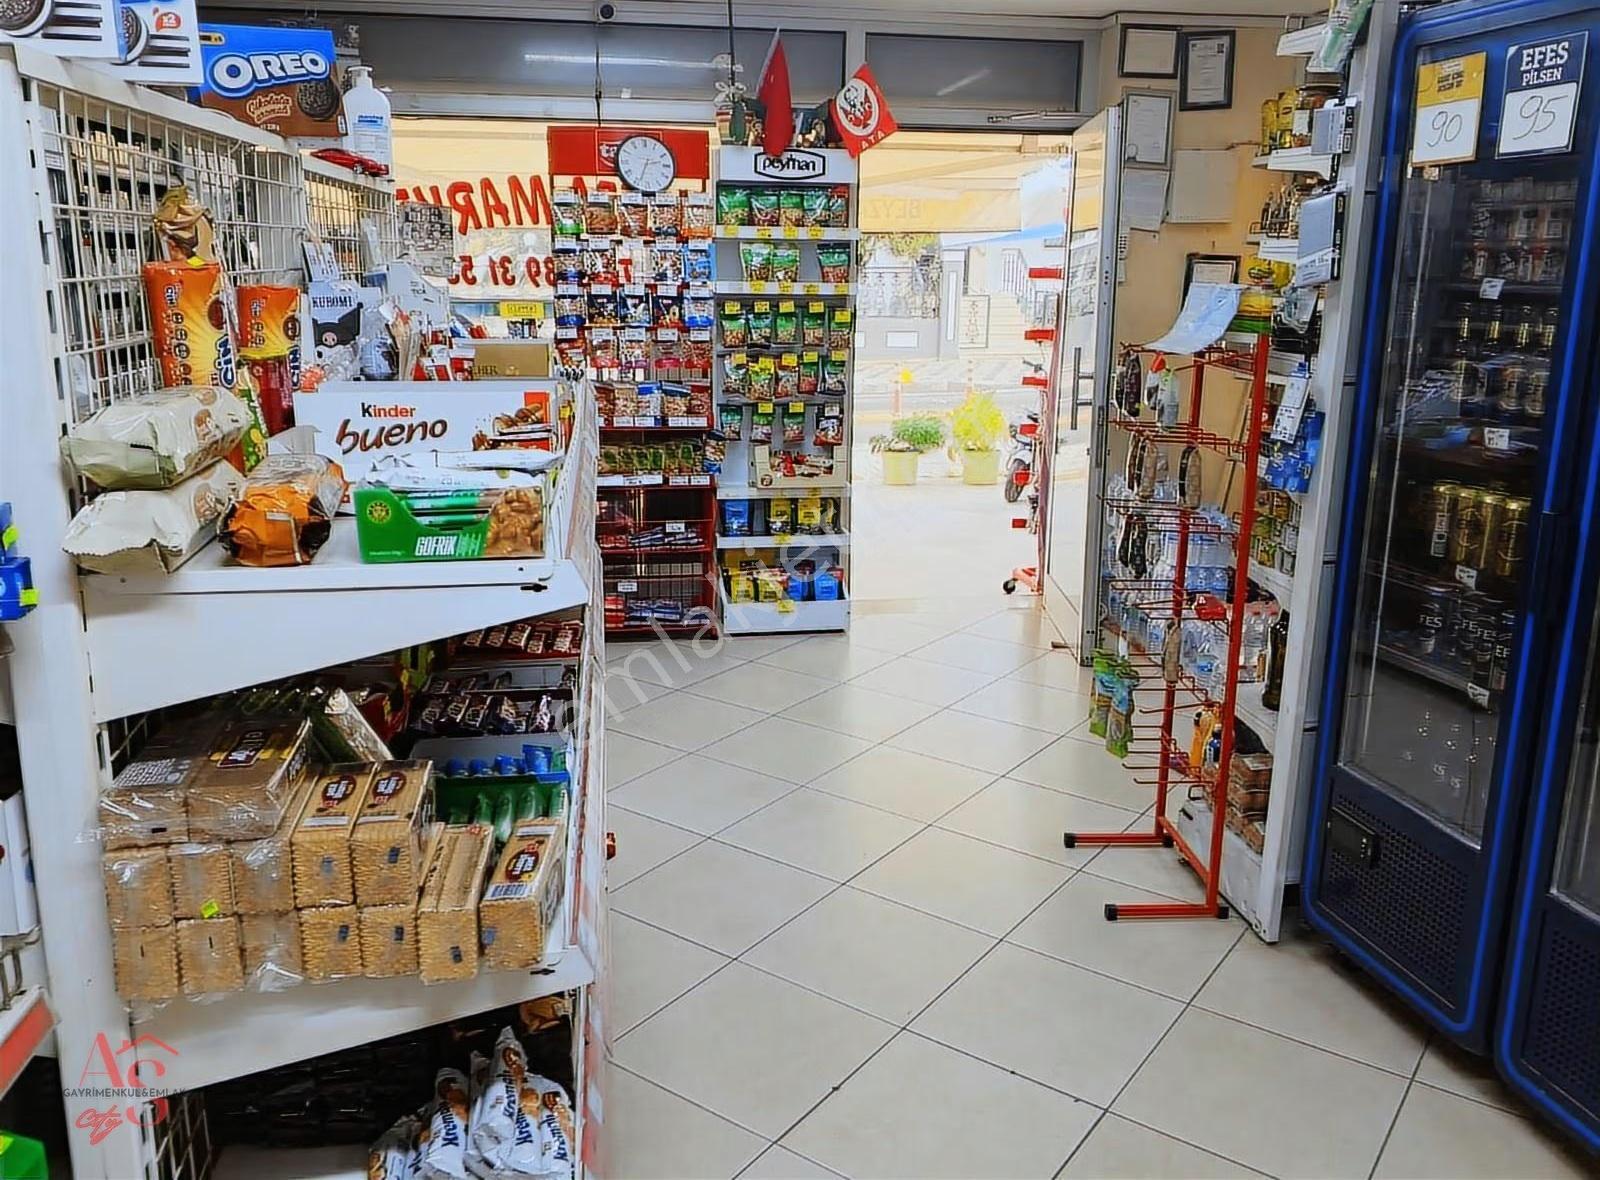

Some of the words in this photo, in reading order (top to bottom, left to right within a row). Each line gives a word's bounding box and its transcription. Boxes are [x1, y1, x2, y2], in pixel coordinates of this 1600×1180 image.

[213, 52, 326, 90] OREO
[1520, 41, 1569, 71] EFES
[1426, 110, 1463, 147] 90
[1512, 94, 1569, 140] 95
[763, 154, 816, 172] peyman
[312, 294, 353, 308] KUROMI
[336, 418, 448, 455] bueno
